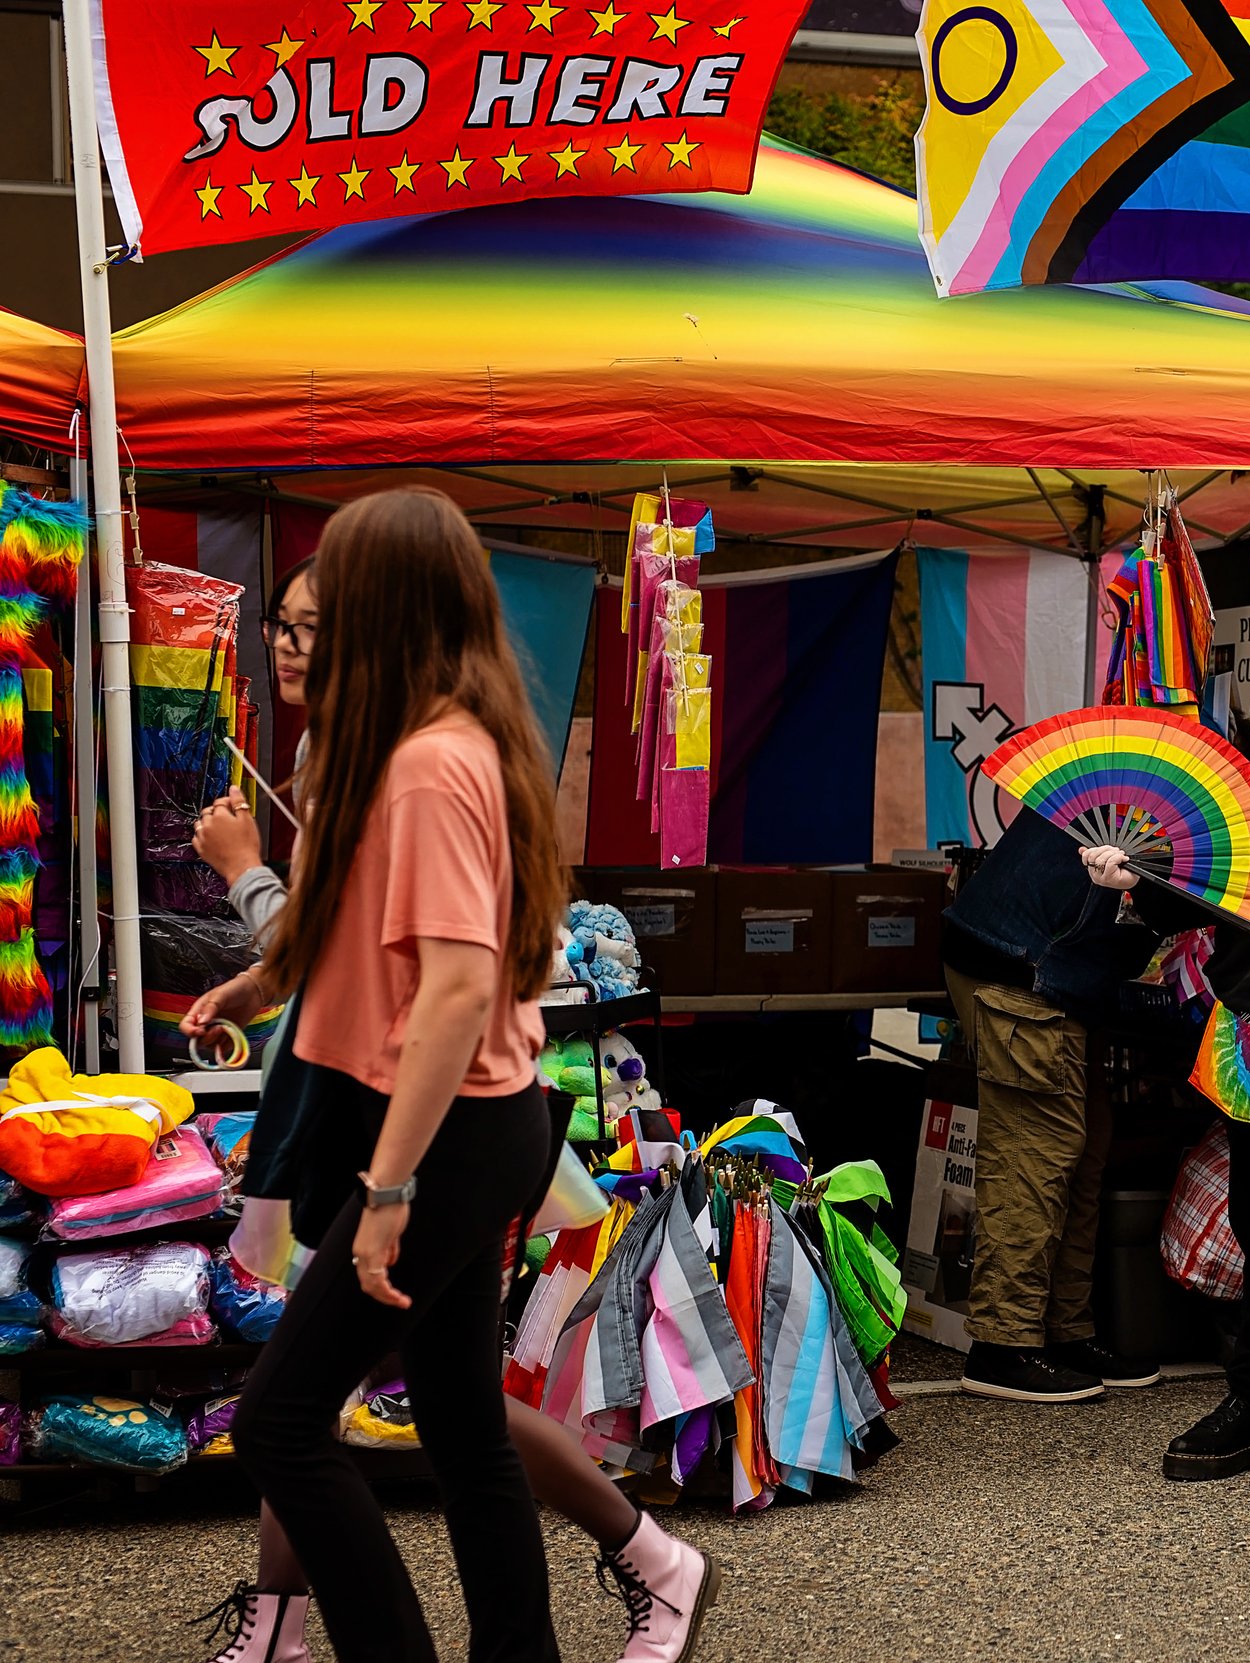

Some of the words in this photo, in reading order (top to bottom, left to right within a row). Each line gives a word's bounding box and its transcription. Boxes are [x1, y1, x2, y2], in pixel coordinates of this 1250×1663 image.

[183, 53, 428, 161] SOLD
[462, 50, 746, 129] HERE
[944, 1157, 973, 1188] Foam
